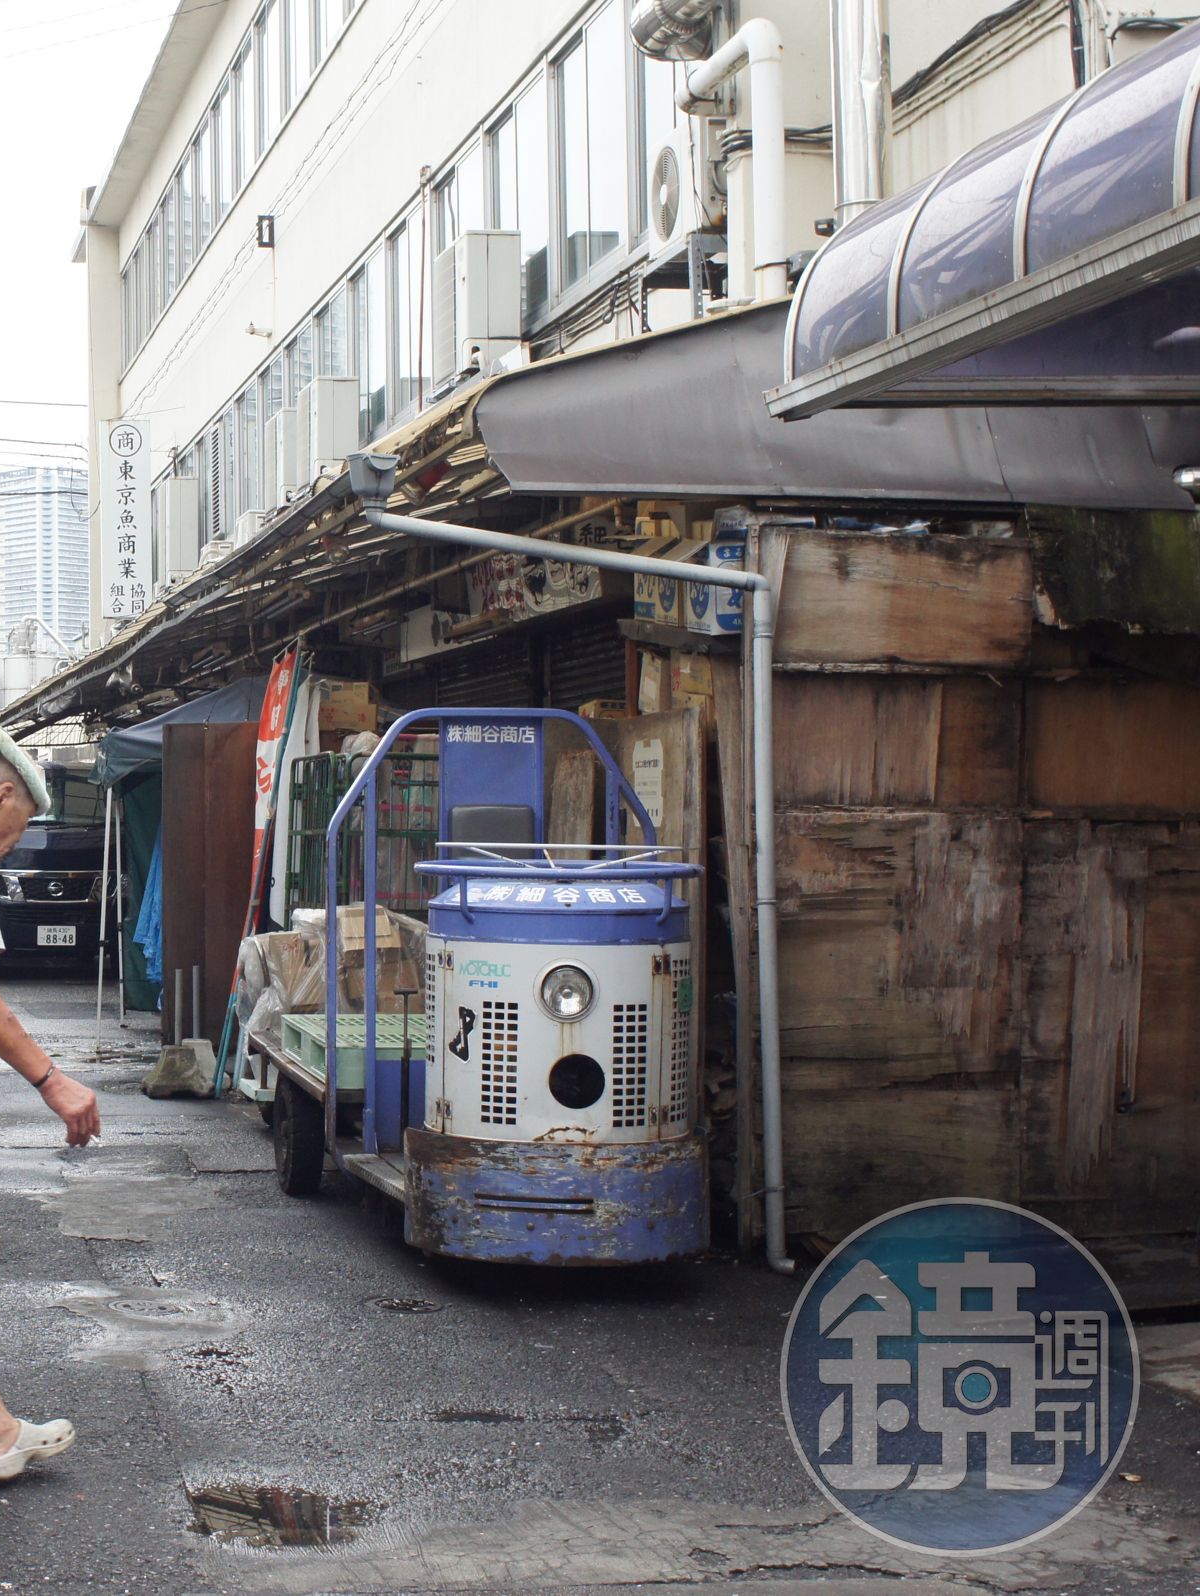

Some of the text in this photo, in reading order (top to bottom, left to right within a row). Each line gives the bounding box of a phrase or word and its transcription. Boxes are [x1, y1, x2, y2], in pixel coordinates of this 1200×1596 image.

[115, 459, 138, 580] 東京魚商業
[45, 934, 74, 944] 88-48
